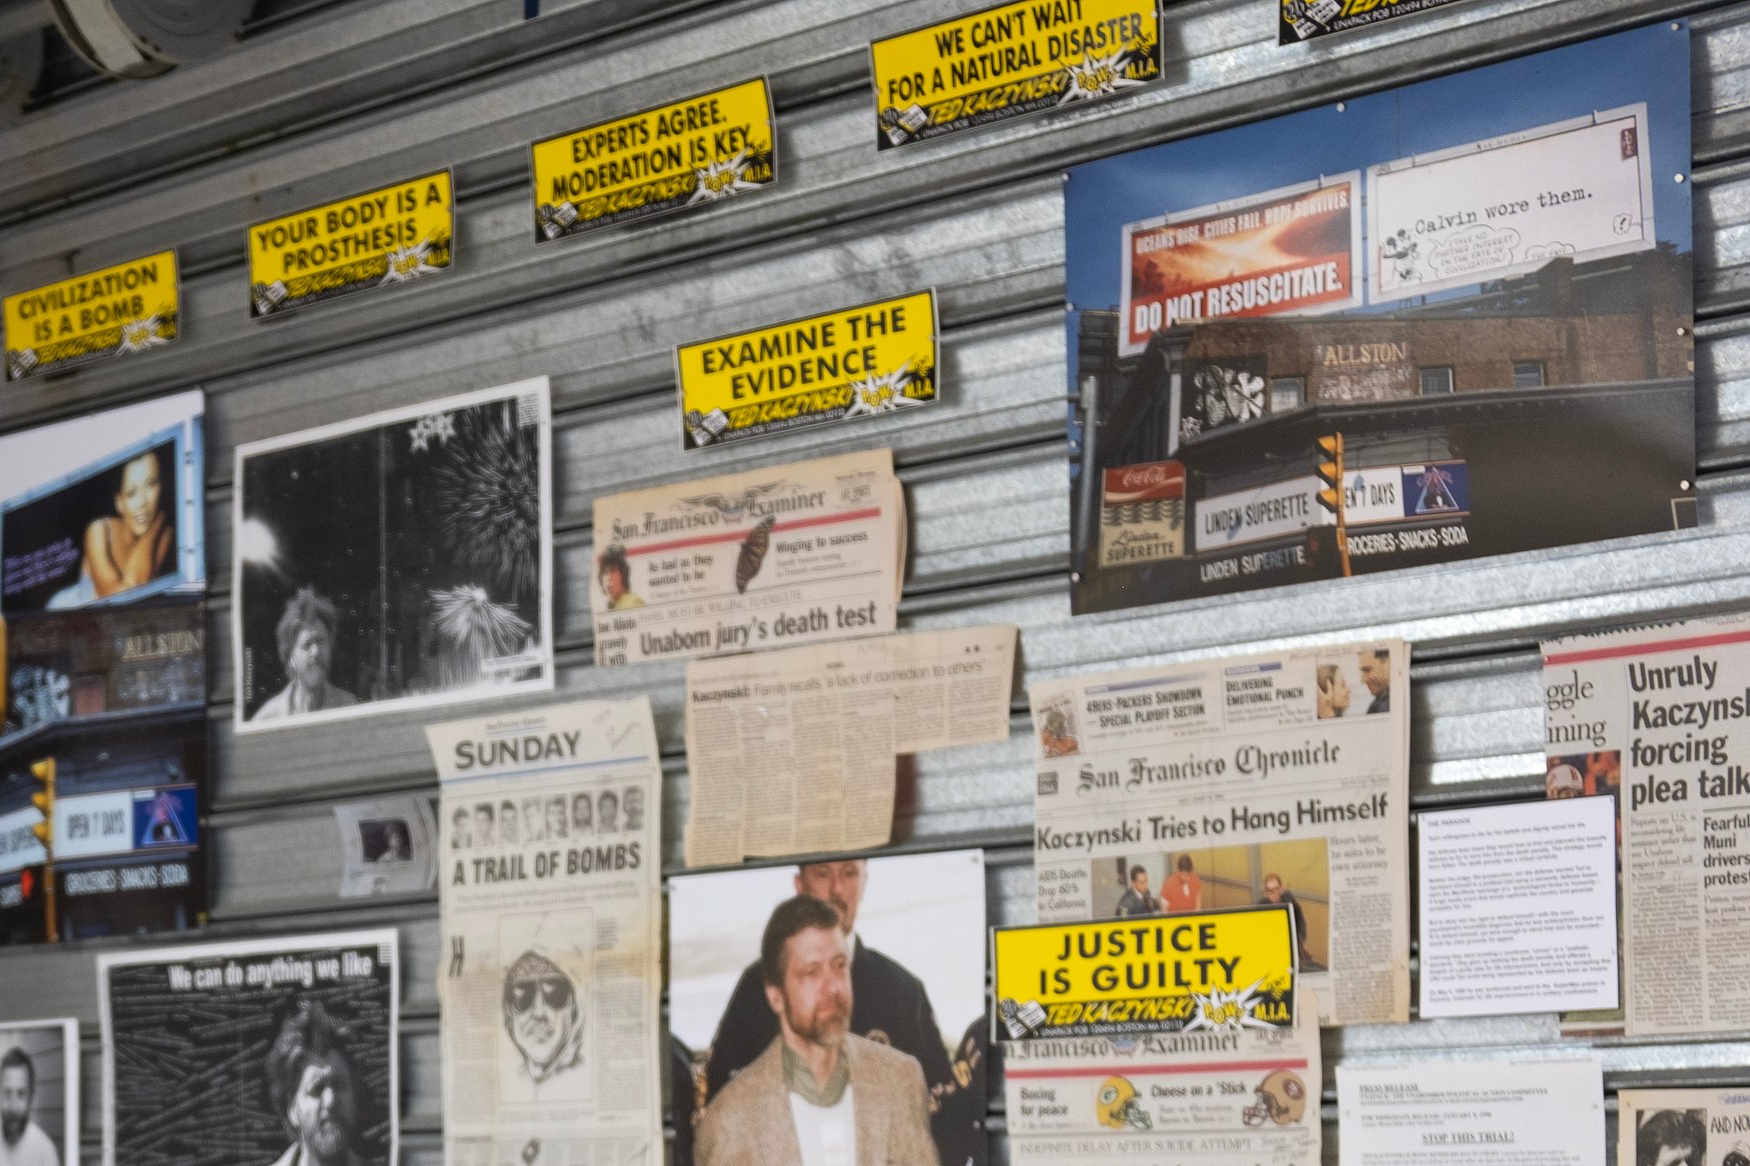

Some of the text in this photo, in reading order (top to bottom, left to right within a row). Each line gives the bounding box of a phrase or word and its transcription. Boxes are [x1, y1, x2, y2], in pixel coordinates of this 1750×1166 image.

[935, 0, 1083, 58] WE CAN'T WAIT
[888, 12, 1143, 104] FOR A NATURAL DISASTER
[571, 99, 728, 163] EXPERTS AGREE.
[553, 136, 709, 200] MODERATION IS
[256, 182, 441, 252] YOUR BODY IS A
[1415, 187, 1593, 236] Calvin wore them.
[283, 217, 418, 274] PROSTHESIS
[18, 264, 158, 320] CIVILIZATION
[1135, 261, 1343, 335] DO NOT RESUSCITATE.
[34, 295, 145, 342] IS A BOMB
[702, 306, 907, 375] EXAMINE THE
[1323, 342, 1408, 366] ALLSTON
[732, 345, 877, 400] EVIDENCE
[1206, 492, 1310, 535] LINDEN SUPERETTE
[1371, 483, 1395, 506] DAYS
[612, 488, 826, 541] San Francisco Examiner
[776, 532, 868, 555] Winging to success
[1107, 542, 1176, 562] SUPERETTE
[1201, 546, 1306, 582] LINDEN SUPERETTE
[640, 626, 711, 656] Unabom
[715, 618, 768, 651] jury's
[774, 605, 830, 638] death
[836, 600, 877, 629] test
[1226, 676, 1274, 692] DELIVERING
[1629, 655, 1718, 692] Unruly
[1135, 707, 1169, 724] PLAYOFF
[1173, 703, 1206, 719] SECTION
[1276, 686, 1304, 702] PUNCH
[455, 730, 581, 769] SUNDAY
[1076, 739, 1340, 797] San Francisco Chronicle
[1631, 733, 1728, 767] forcing
[1632, 774, 1688, 810] plea
[67, 809, 126, 838] OPEN DAYS
[1037, 791, 1389, 853] Kaczynski Tries to Hang Himself
[1703, 814, 1750, 831] Fearful
[1703, 833, 1737, 849] Muni
[452, 841, 641, 886] A TRAIL OF BOMBS
[1703, 853, 1750, 868] drivers
[1057, 922, 1218, 961] JUSTICE
[168, 951, 372, 990] We can do anything we like
[1039, 956, 1242, 996] IS GUILTY
[1045, 996, 1195, 1025] TED KACZYNSKI
[1116, 1022, 1146, 1033] BOSTON
[1254, 1001, 1290, 1021] M.I.A.
[1021, 1088, 1056, 1102] Boxing
[1151, 1084, 1213, 1097] Cheese on a
[1021, 1104, 1069, 1119] for peace
